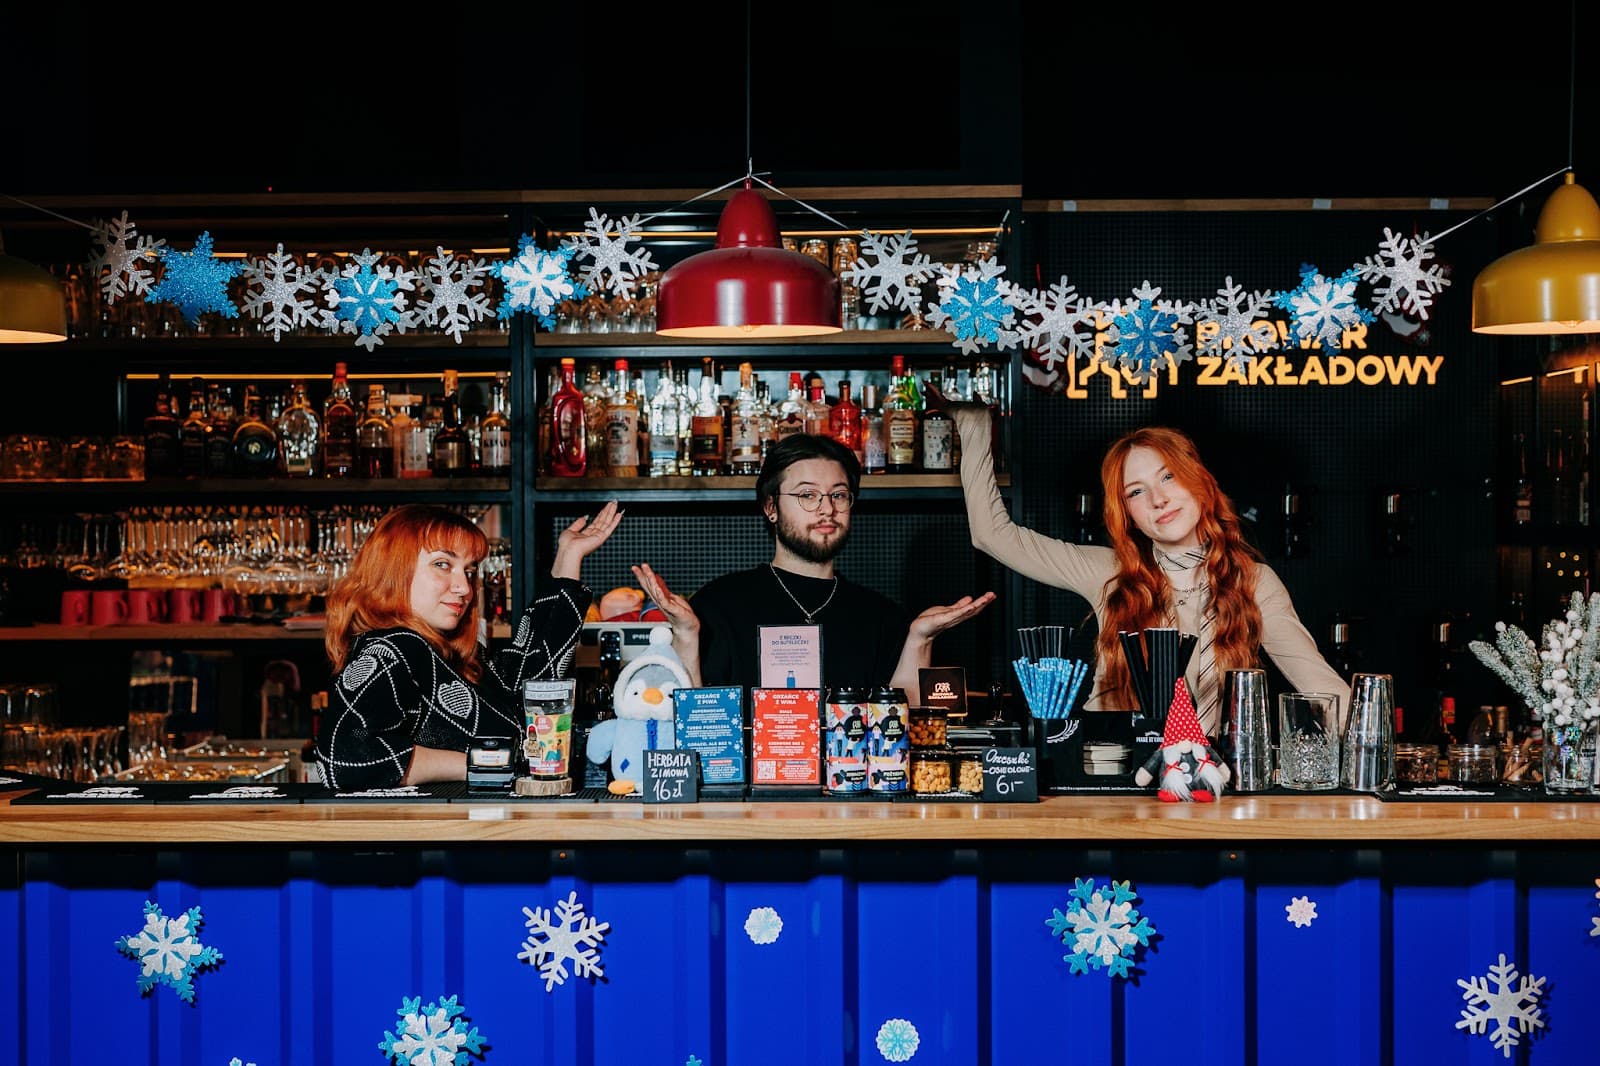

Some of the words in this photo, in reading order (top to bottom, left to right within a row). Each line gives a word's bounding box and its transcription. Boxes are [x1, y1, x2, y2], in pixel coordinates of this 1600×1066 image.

[1196, 355, 1444, 386] ZAKŁADOWY
[647, 752, 692, 768] HERBATA
[651, 768, 689, 778] ZIMOWA
